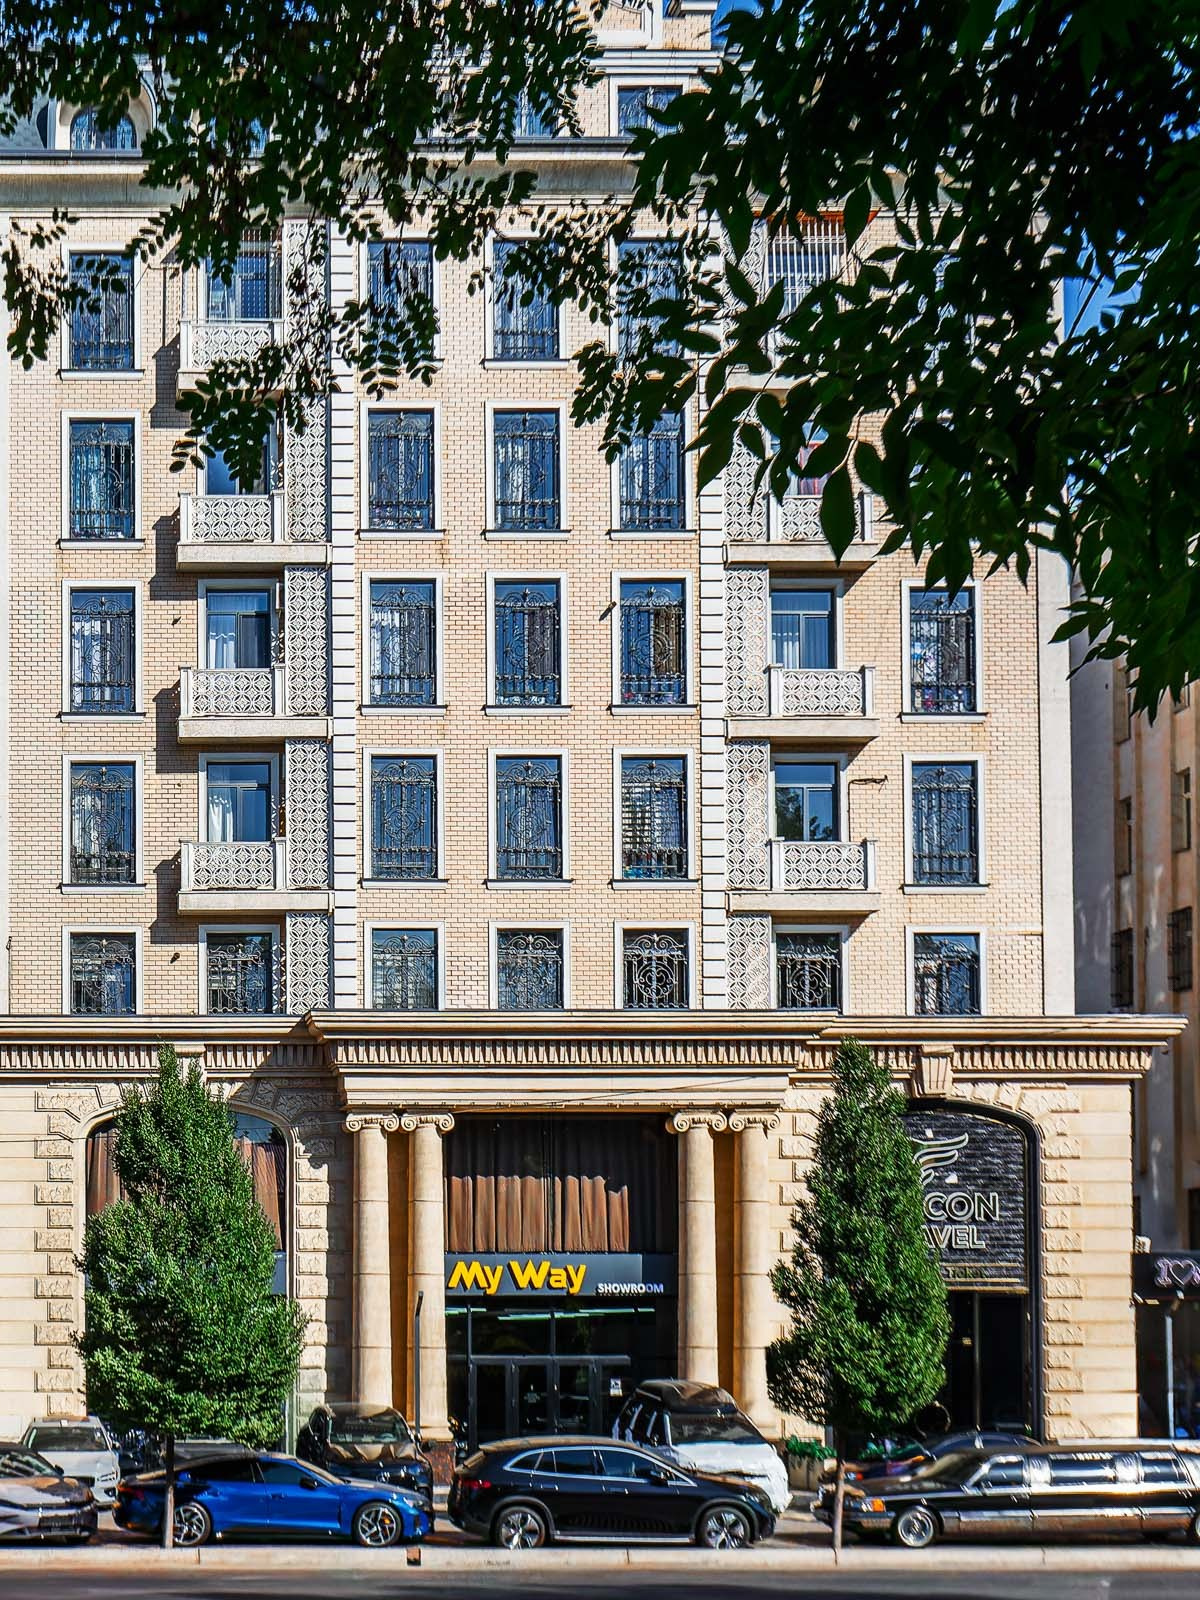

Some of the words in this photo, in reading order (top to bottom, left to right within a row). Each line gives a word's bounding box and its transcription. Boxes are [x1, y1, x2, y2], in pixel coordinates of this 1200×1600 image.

[923, 1191, 1000, 1221] CON
[448, 1261, 504, 1294] My
[509, 1260, 587, 1294] Way
[597, 1282, 664, 1294] SHOWROOM
